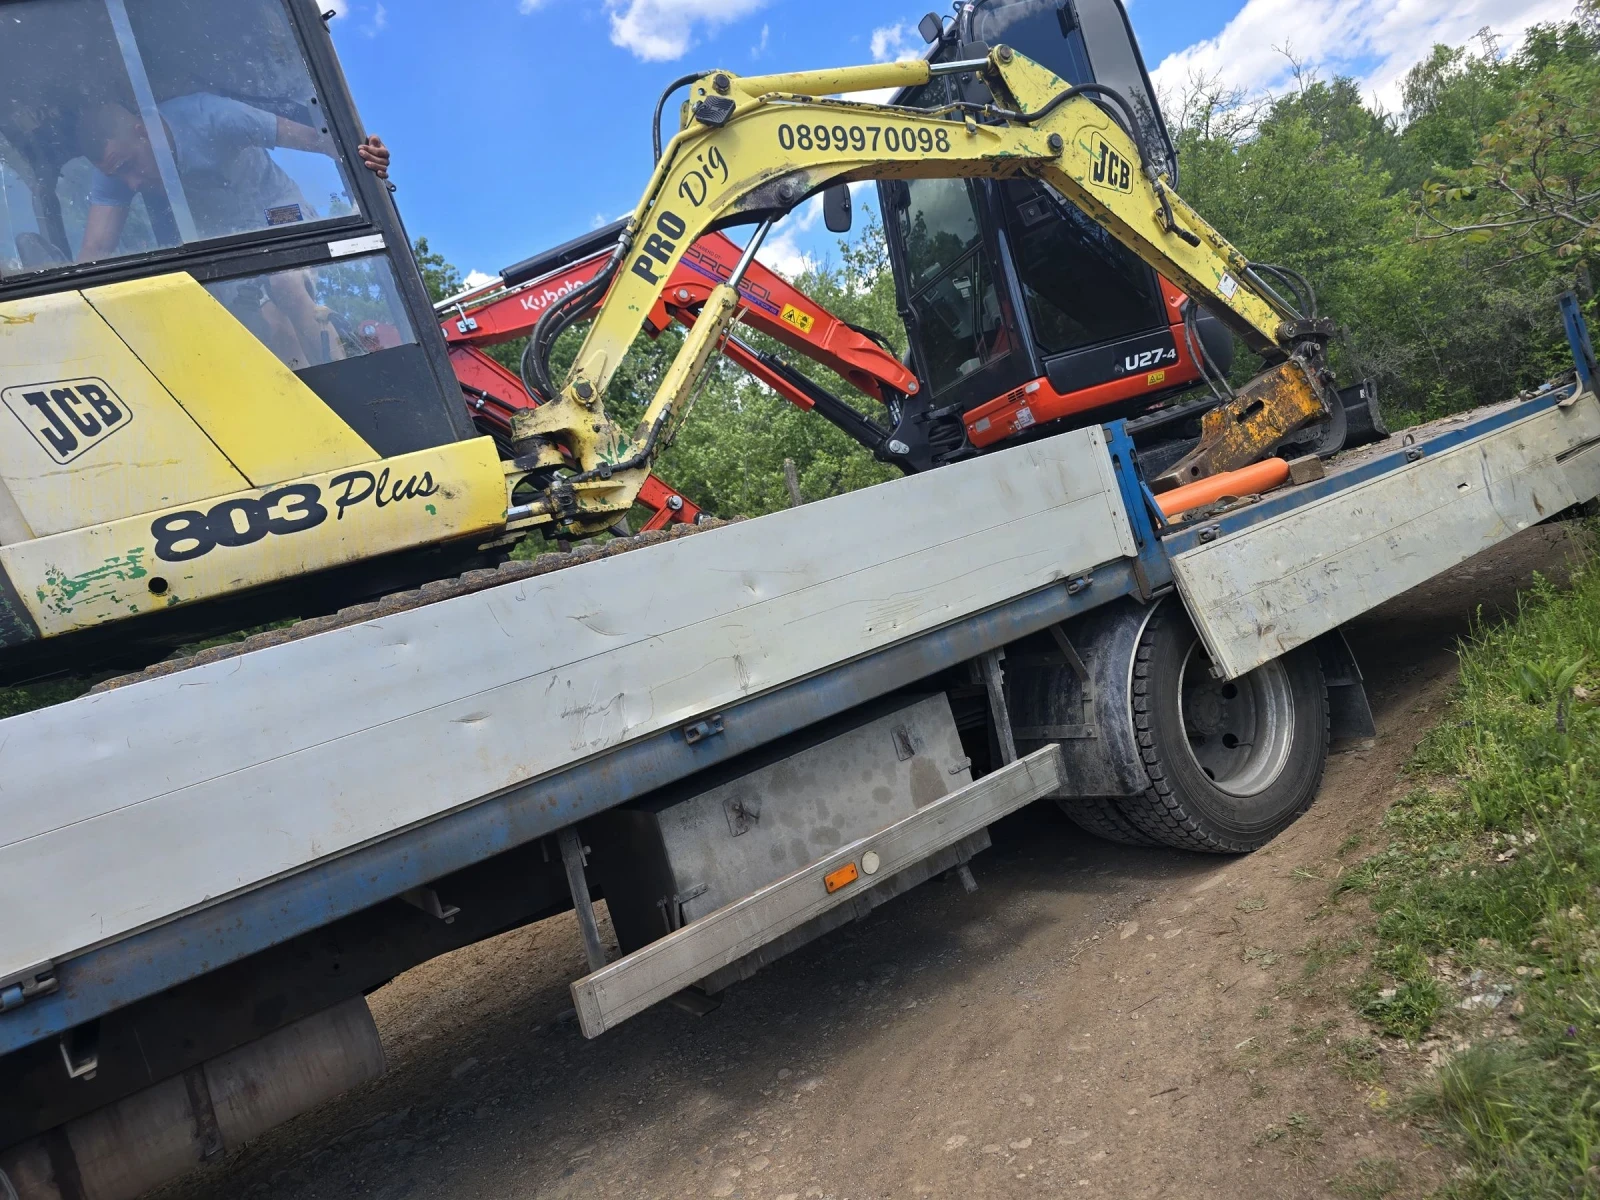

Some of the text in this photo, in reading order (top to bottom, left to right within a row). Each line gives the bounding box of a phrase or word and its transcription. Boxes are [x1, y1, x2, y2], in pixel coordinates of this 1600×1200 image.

[777, 123, 951, 153] 0899970098
[1093, 142, 1130, 189] JCB
[631, 210, 686, 285] PRO
[678, 145, 729, 207] Dig
[1125, 347, 1176, 371] U27-4
[28, 383, 123, 458] JCB
[150, 467, 440, 563] 803 Plus
